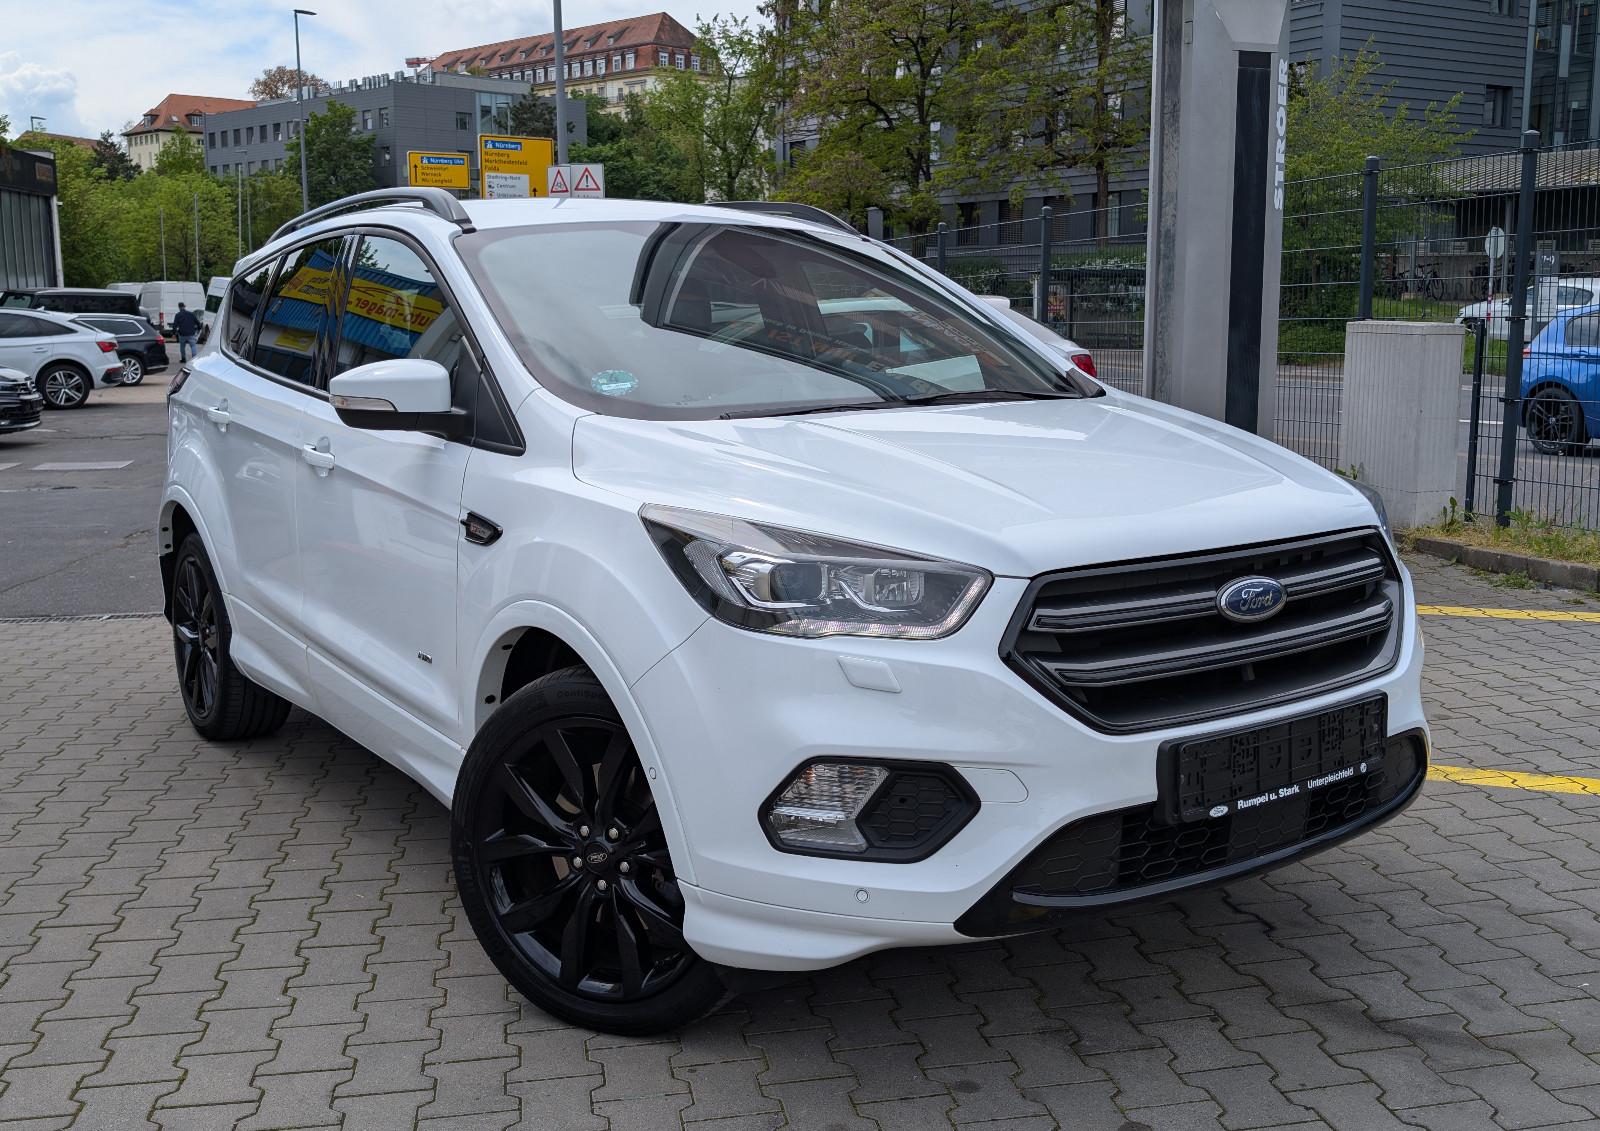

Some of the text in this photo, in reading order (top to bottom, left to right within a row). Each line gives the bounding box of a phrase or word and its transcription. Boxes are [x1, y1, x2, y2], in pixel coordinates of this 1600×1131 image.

[495, 142, 521, 151] Nürnberg
[1240, 587, 1273, 611] Ford
[1237, 767, 1354, 810] Rumpel u. Stark Unterpleichfeld
